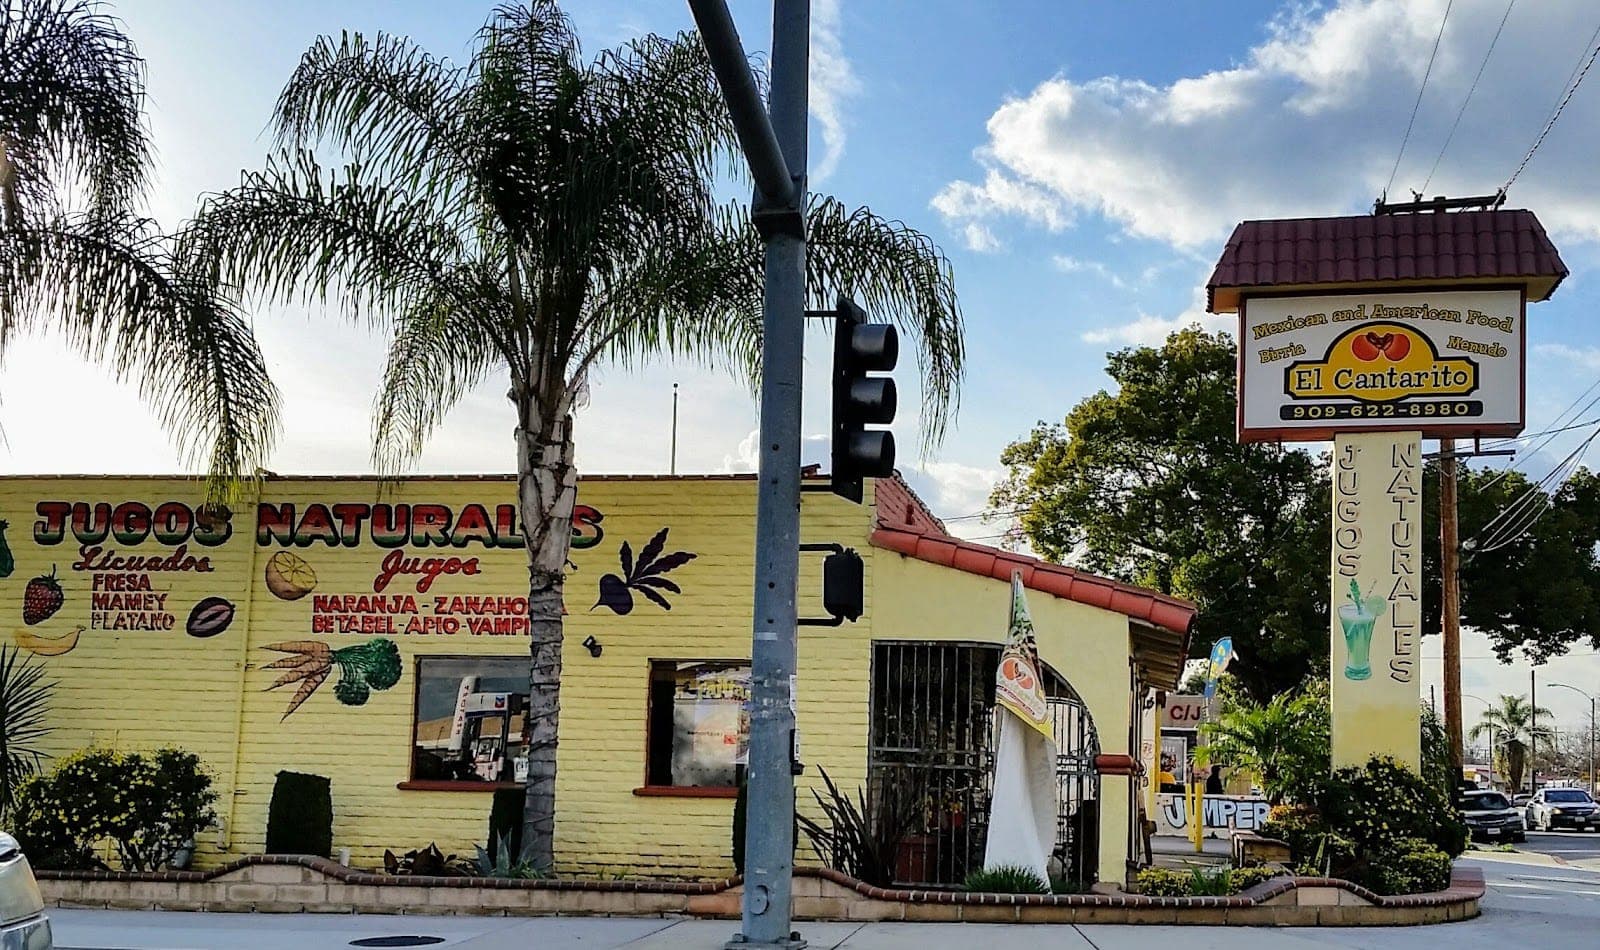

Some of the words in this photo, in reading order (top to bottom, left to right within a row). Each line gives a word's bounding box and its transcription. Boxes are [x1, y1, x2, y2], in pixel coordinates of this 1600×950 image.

[1252, 316, 1328, 340] Mexican
[1332, 305, 1368, 322] and
[1371, 304, 1461, 322] American
[1466, 310, 1513, 333] Food
[1259, 342, 1306, 363] Birria
[1447, 336, 1508, 357] Menudo
[1296, 368, 1323, 390] El
[1334, 365, 1468, 390] Cantarito
[1294, 403, 1469, 418] 909-622-8980
[1336, 444, 1362, 577] JUGOS
[34, 501, 233, 547] JUGOS
[257, 502, 604, 549] NATURALS
[373, 549, 482, 593] Jugos
[1386, 443, 1418, 683] NATURALES
[93, 573, 152, 592] FRESA
[92, 592, 168, 611] MAMEY
[313, 595, 418, 614] NARANJA
[434, 596, 568, 615] ZANAHO
[92, 612, 176, 631] PLATANO
